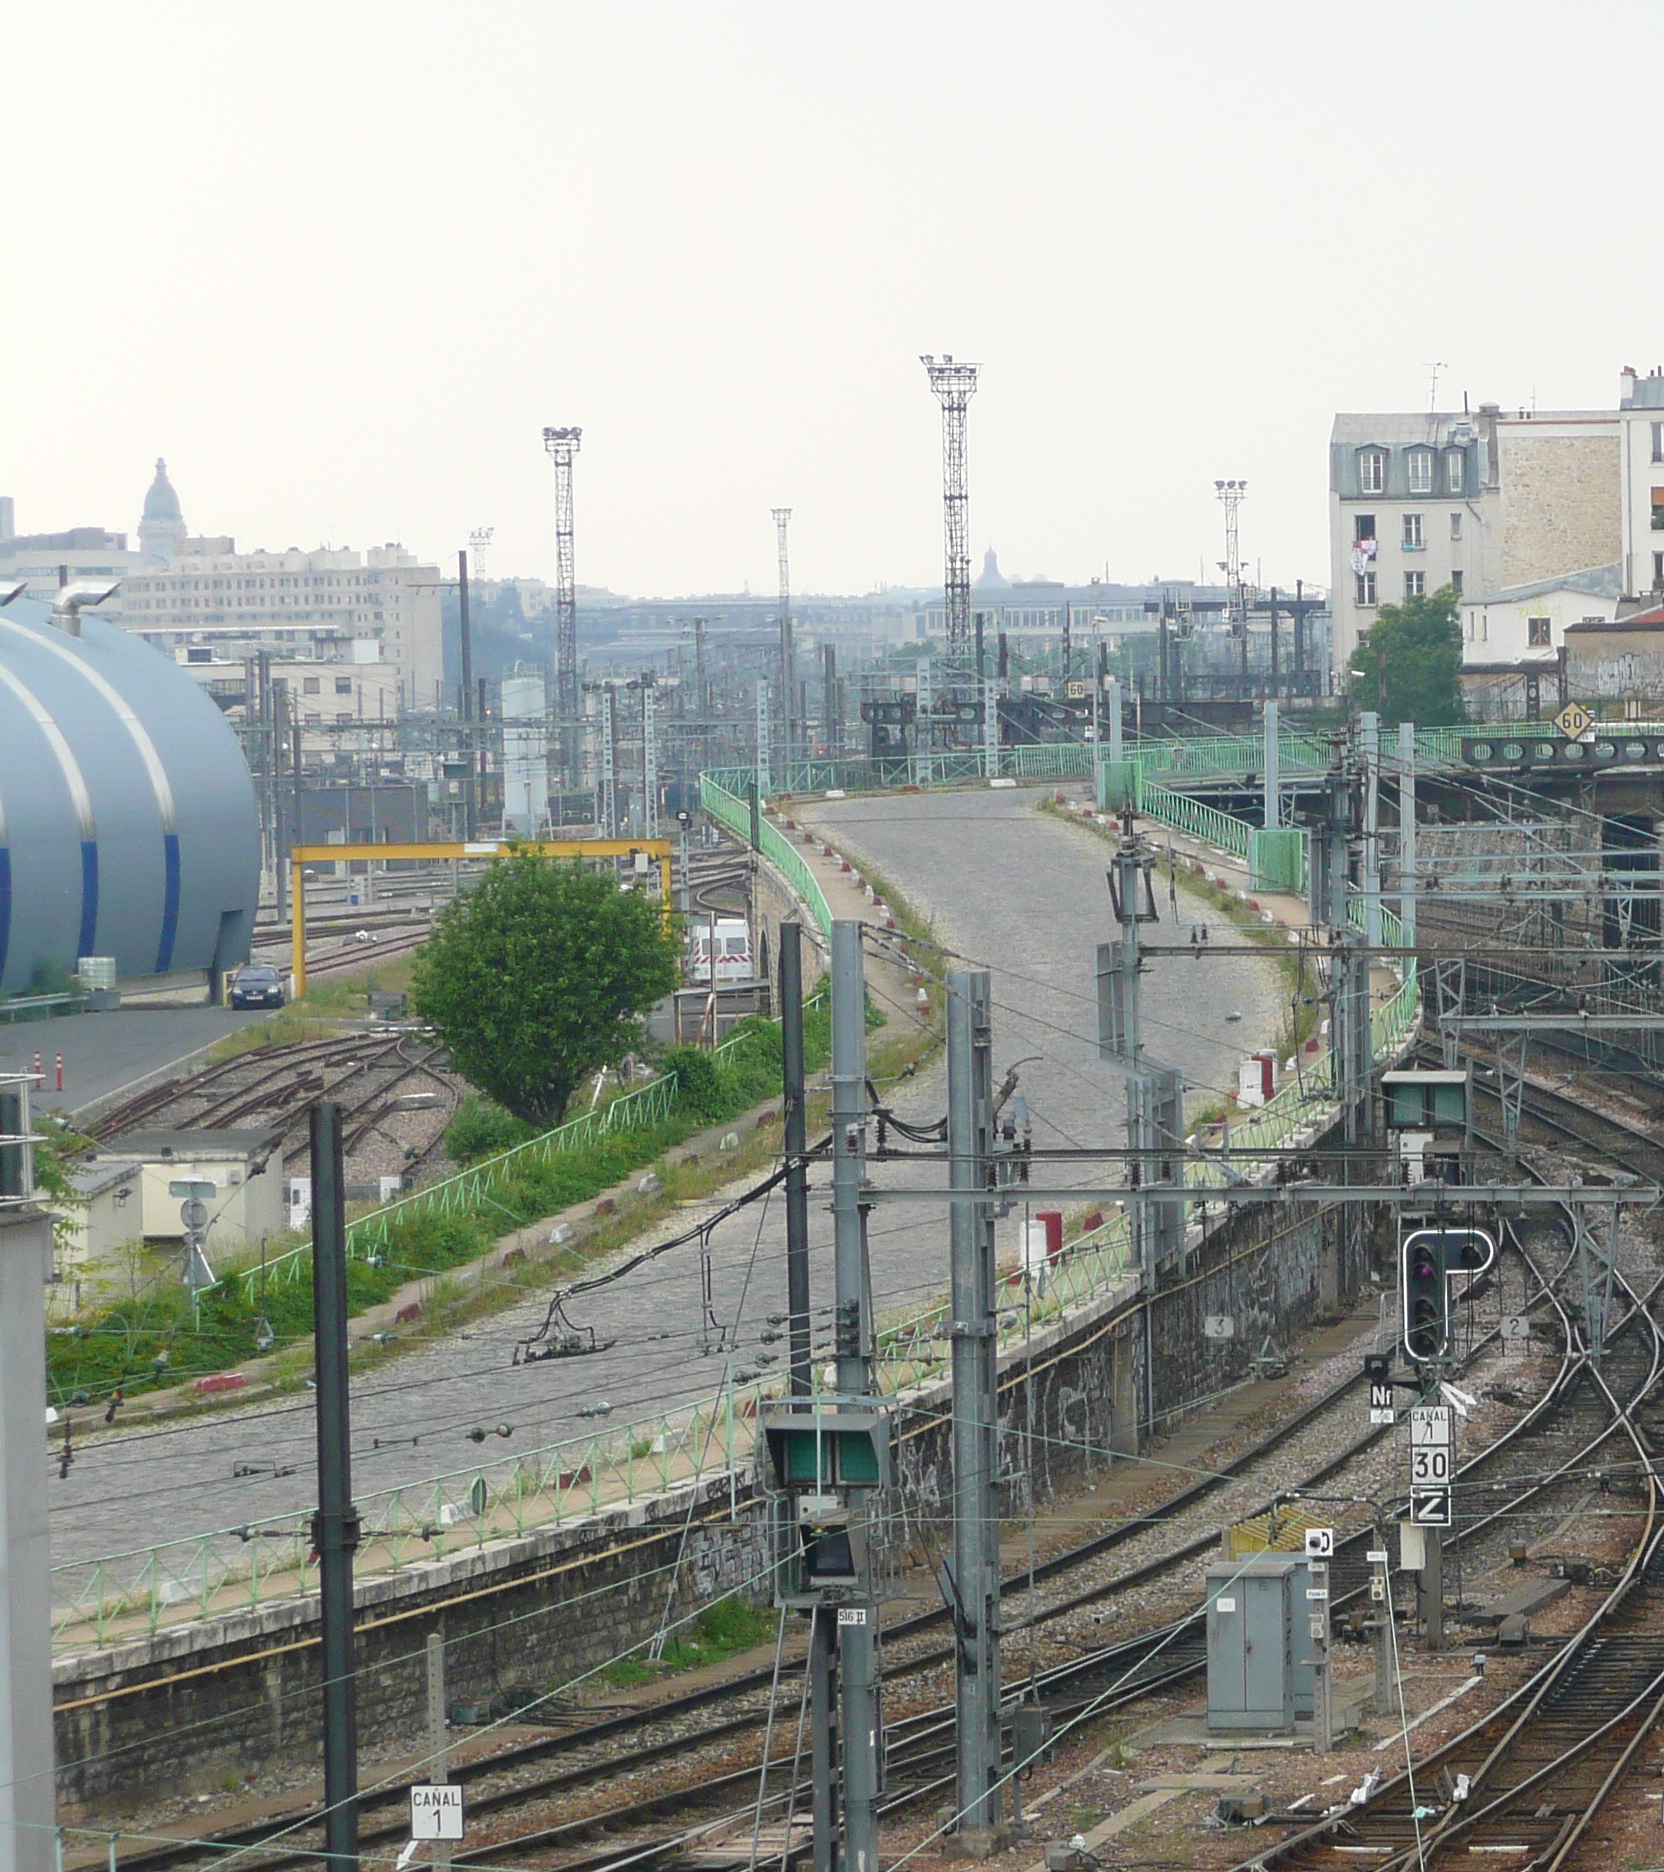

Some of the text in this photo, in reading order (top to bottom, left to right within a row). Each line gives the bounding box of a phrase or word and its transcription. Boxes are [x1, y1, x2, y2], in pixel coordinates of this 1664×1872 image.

[1562, 712, 1583, 729] 60
[1214, 1318, 1225, 1336] 3
[1509, 1318, 1519, 1335] 2
[1412, 1411, 1448, 1422] CANAL
[1414, 1453, 1447, 1478] 30
[838, 1610, 854, 1622] 516
[413, 1791, 461, 1807] CANAL
[432, 1808, 442, 1832] 1
